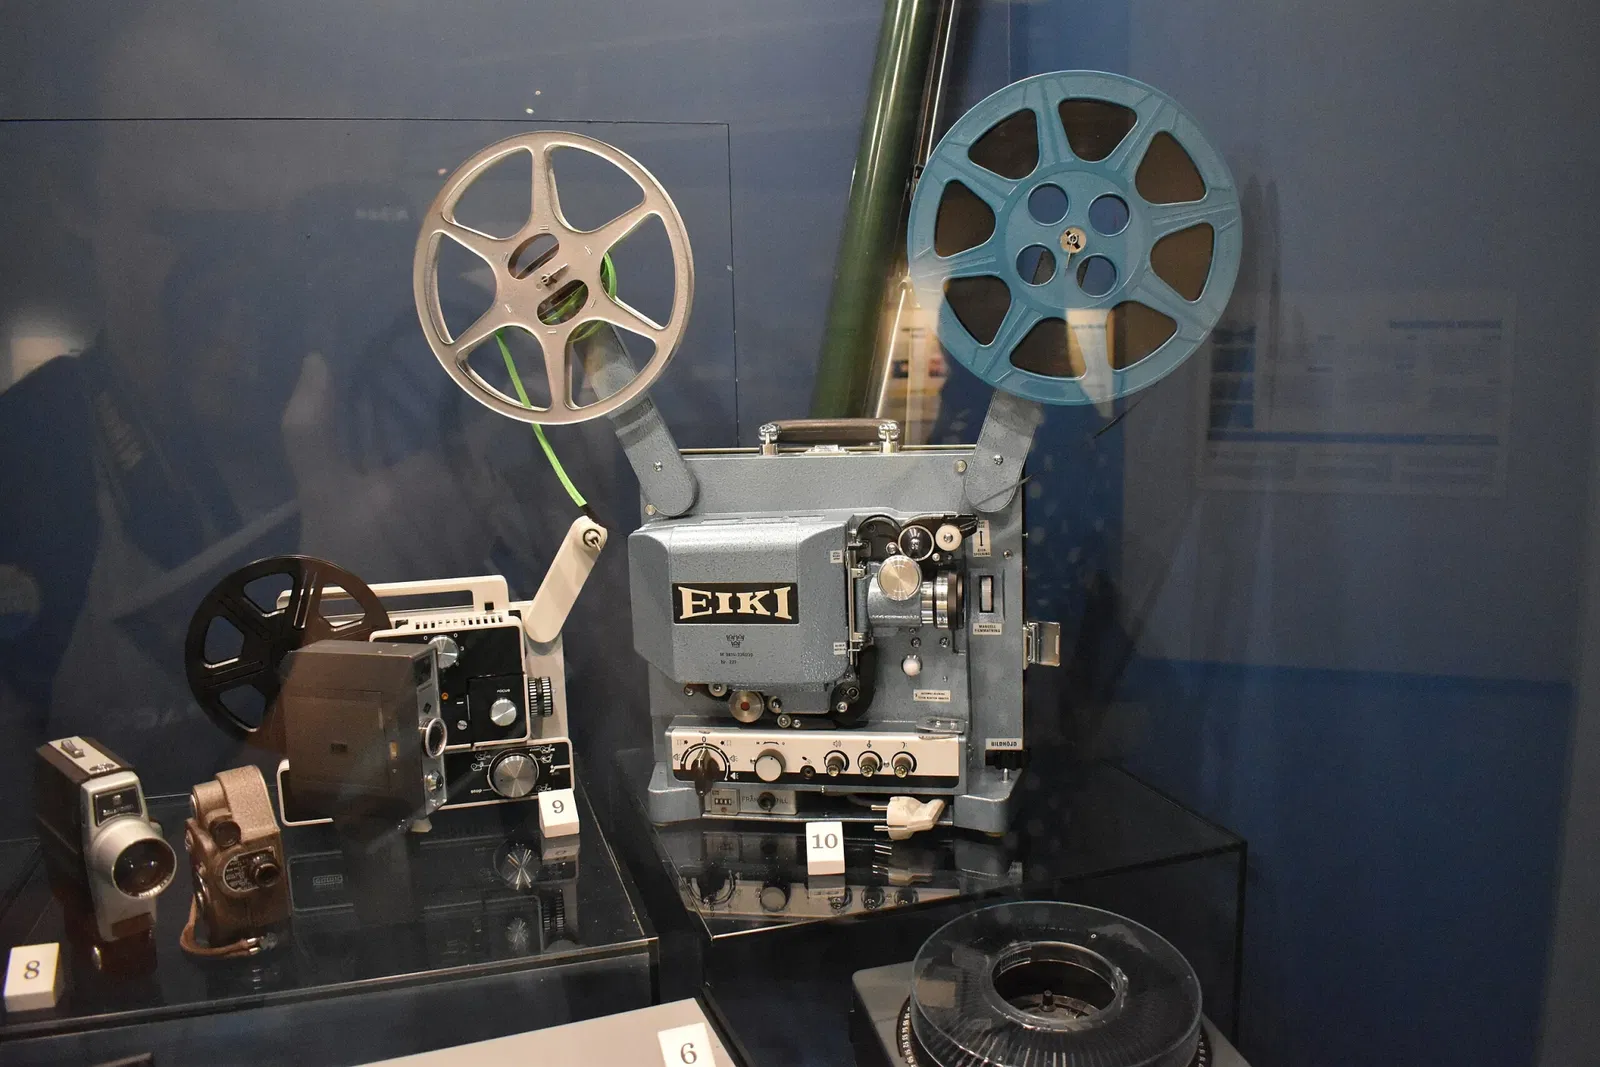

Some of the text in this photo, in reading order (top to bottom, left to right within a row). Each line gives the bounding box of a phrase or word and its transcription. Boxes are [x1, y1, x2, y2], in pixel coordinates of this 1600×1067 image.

[678, 586, 792, 620] EIKI
[552, 799, 565, 814] 9
[811, 833, 839, 849] 10
[23, 960, 41, 980] 8
[680, 1042, 698, 1065] 6
